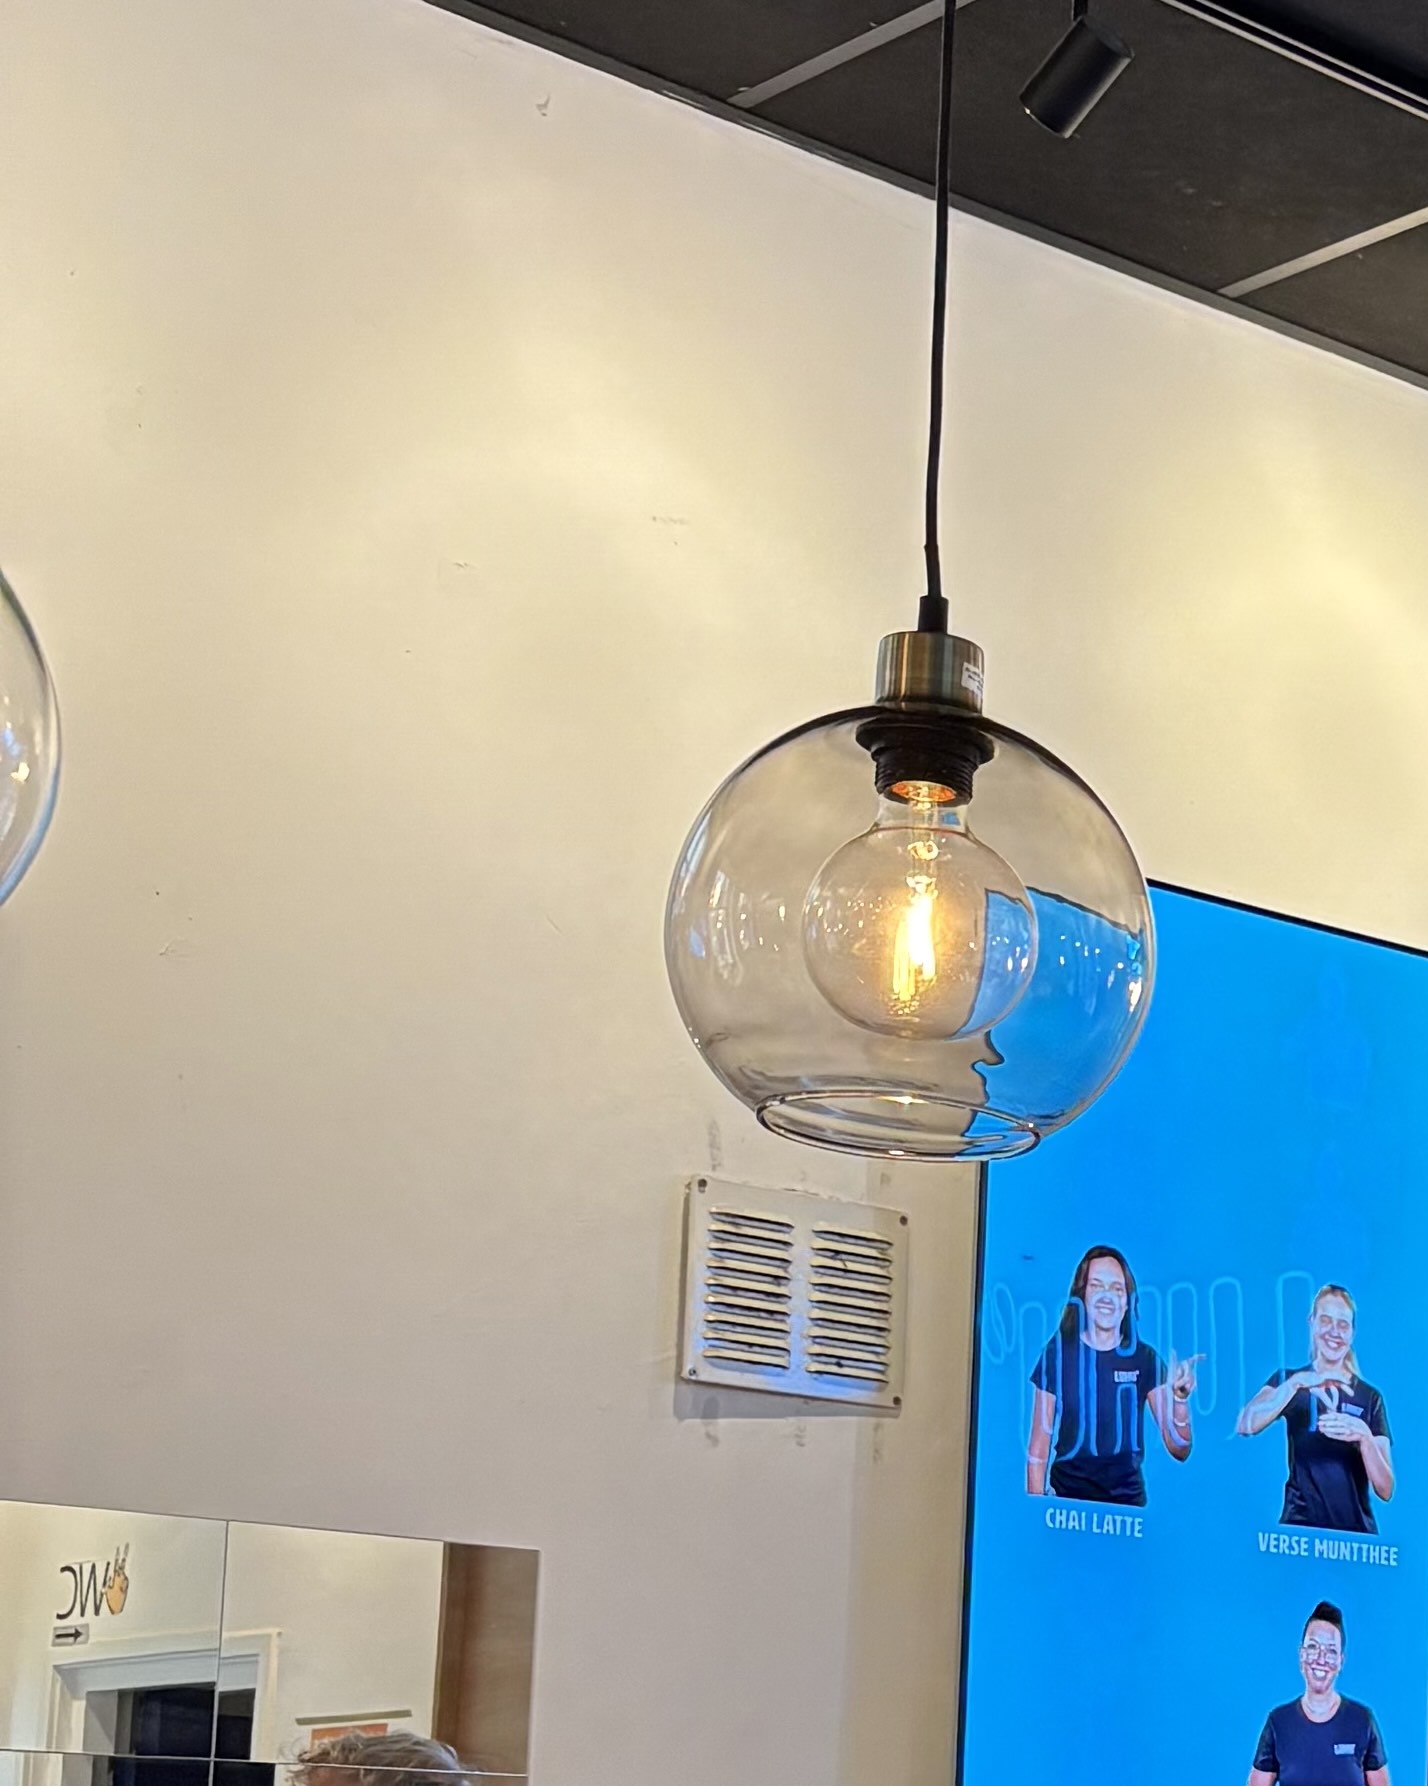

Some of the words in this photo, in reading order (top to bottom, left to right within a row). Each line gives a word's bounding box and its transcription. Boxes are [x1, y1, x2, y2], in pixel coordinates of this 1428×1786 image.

[1045, 1507, 1087, 1532] CHAI
[1092, 1512, 1144, 1538] LATTE
[1258, 1532, 1309, 1557] VERSE
[1314, 1539, 1399, 1566] MUNTTHEE
